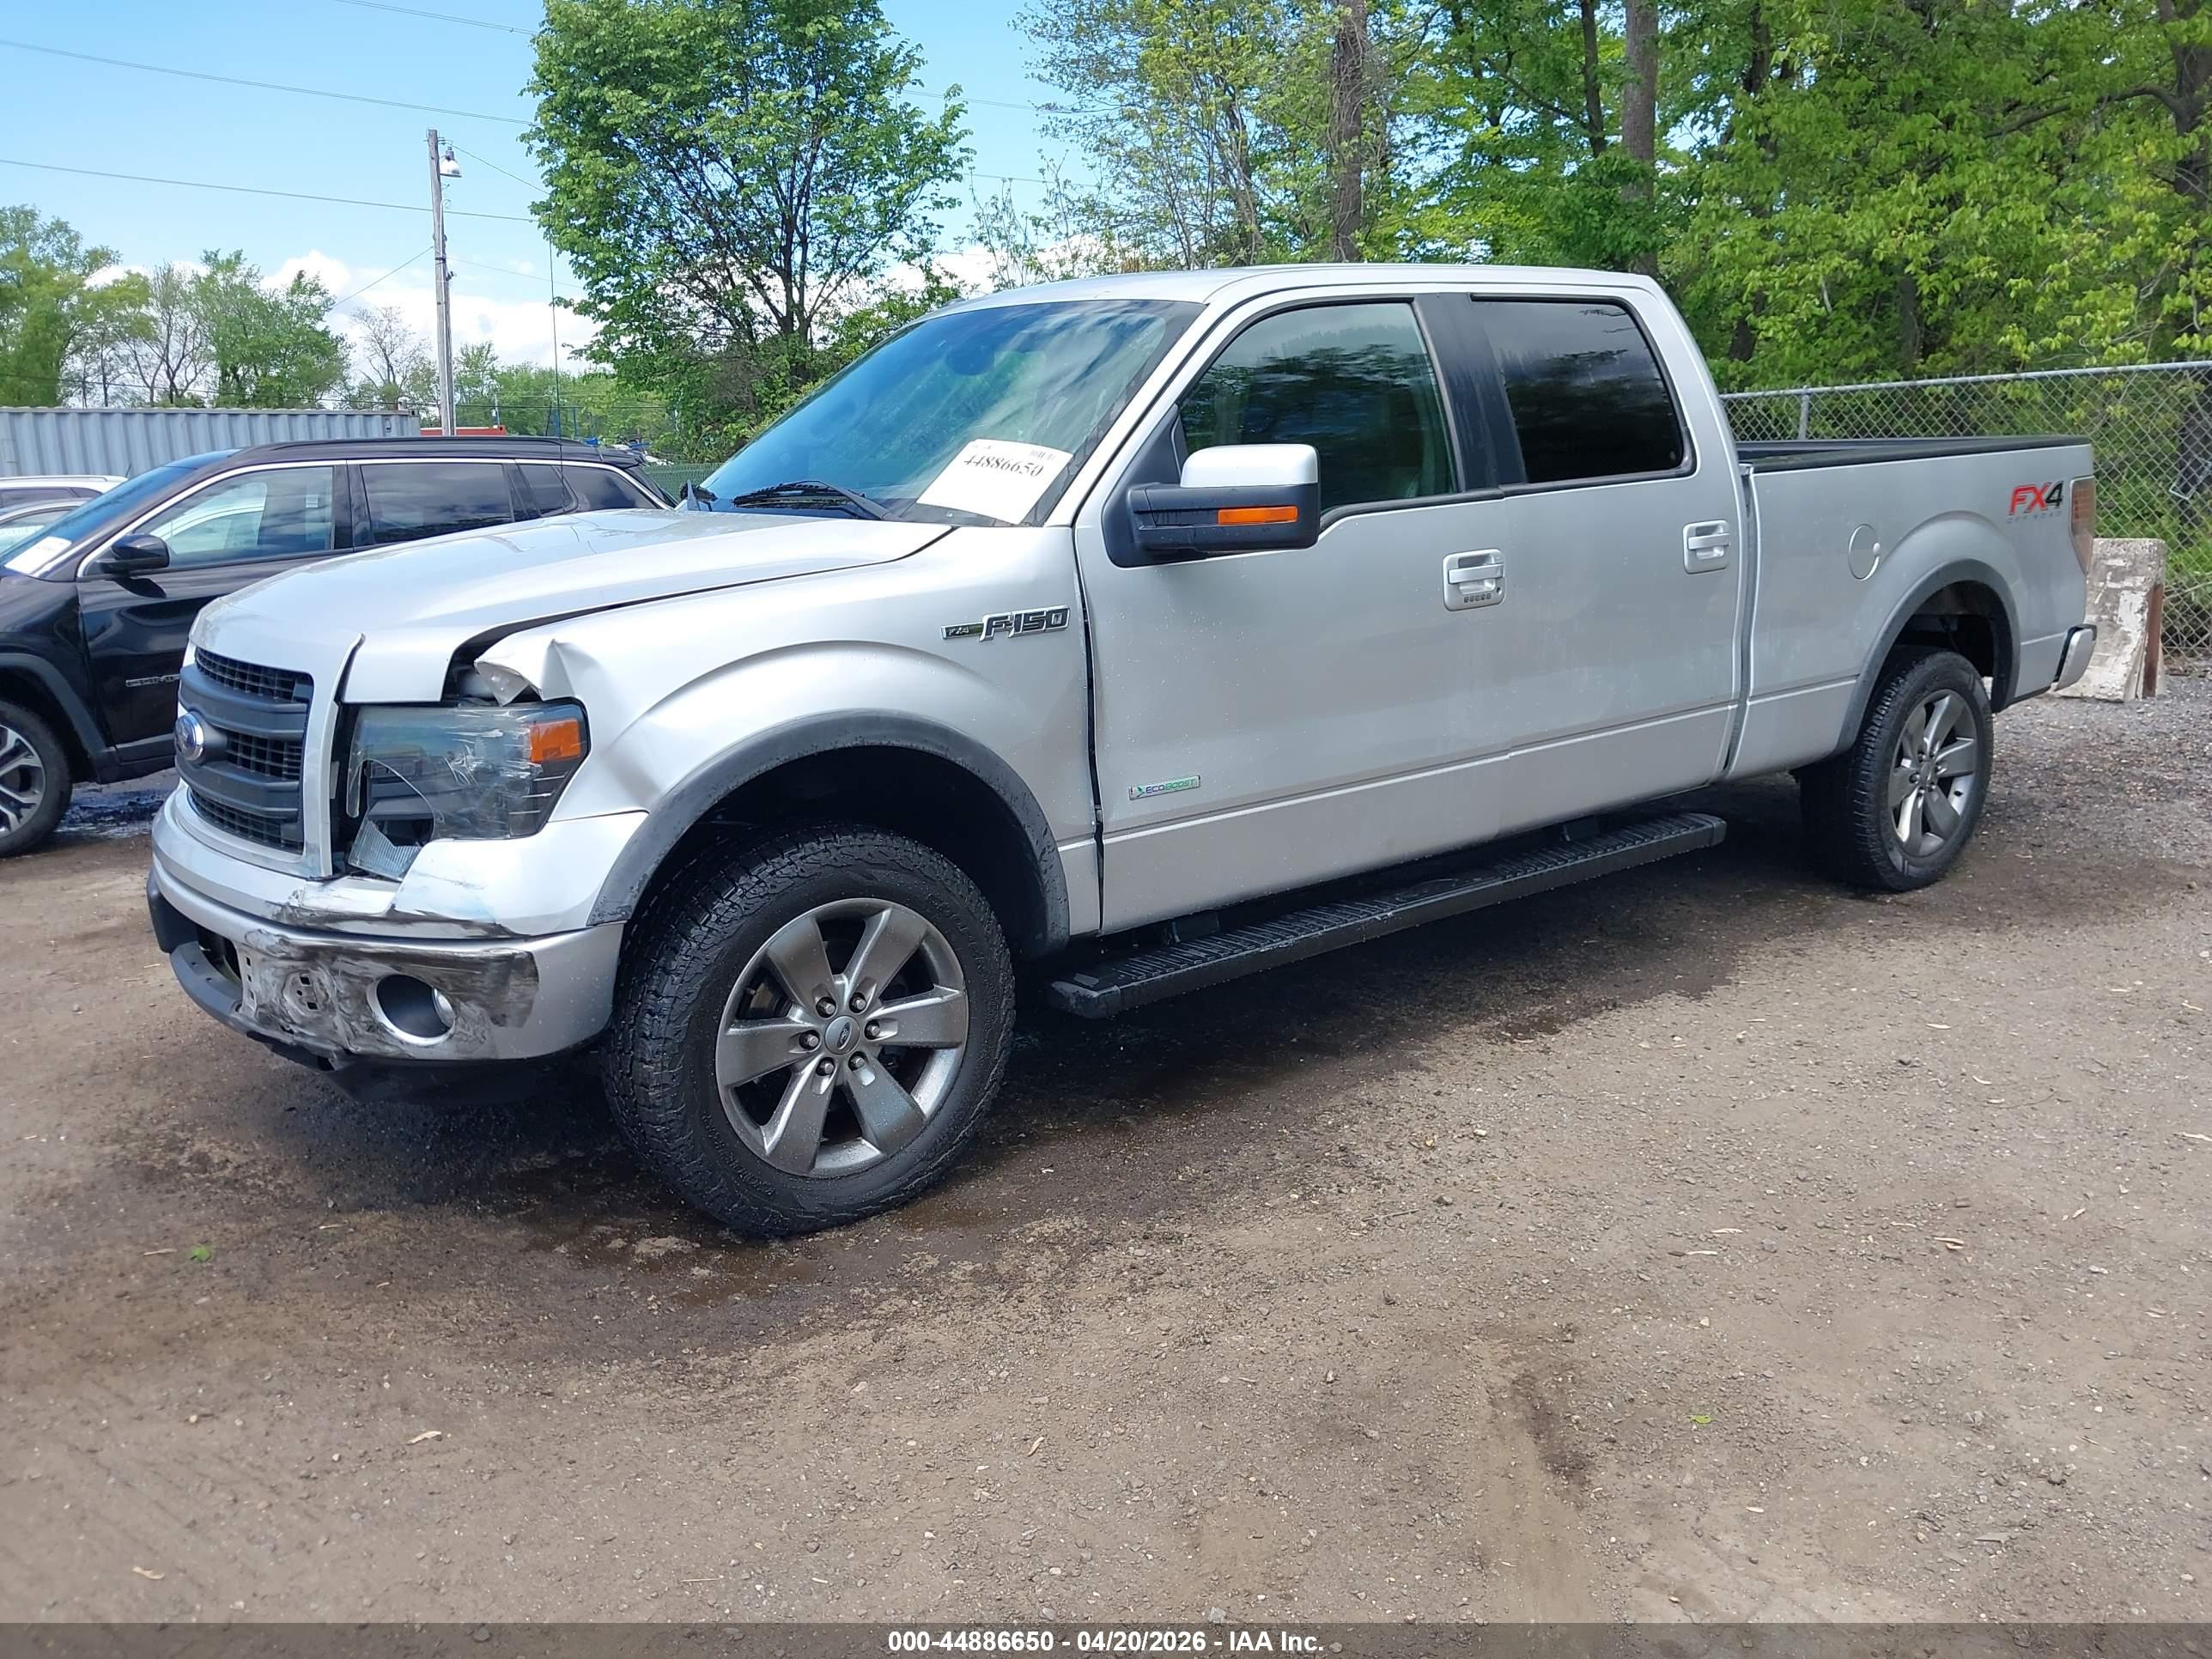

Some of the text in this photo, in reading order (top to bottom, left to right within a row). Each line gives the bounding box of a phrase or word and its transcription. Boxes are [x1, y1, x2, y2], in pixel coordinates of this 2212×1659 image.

[963, 454, 1044, 477] 44886650
[2008, 481, 2064, 515] FX4
[979, 605, 1070, 642] F-150
[1146, 778, 1197, 794] ECOBOOST
